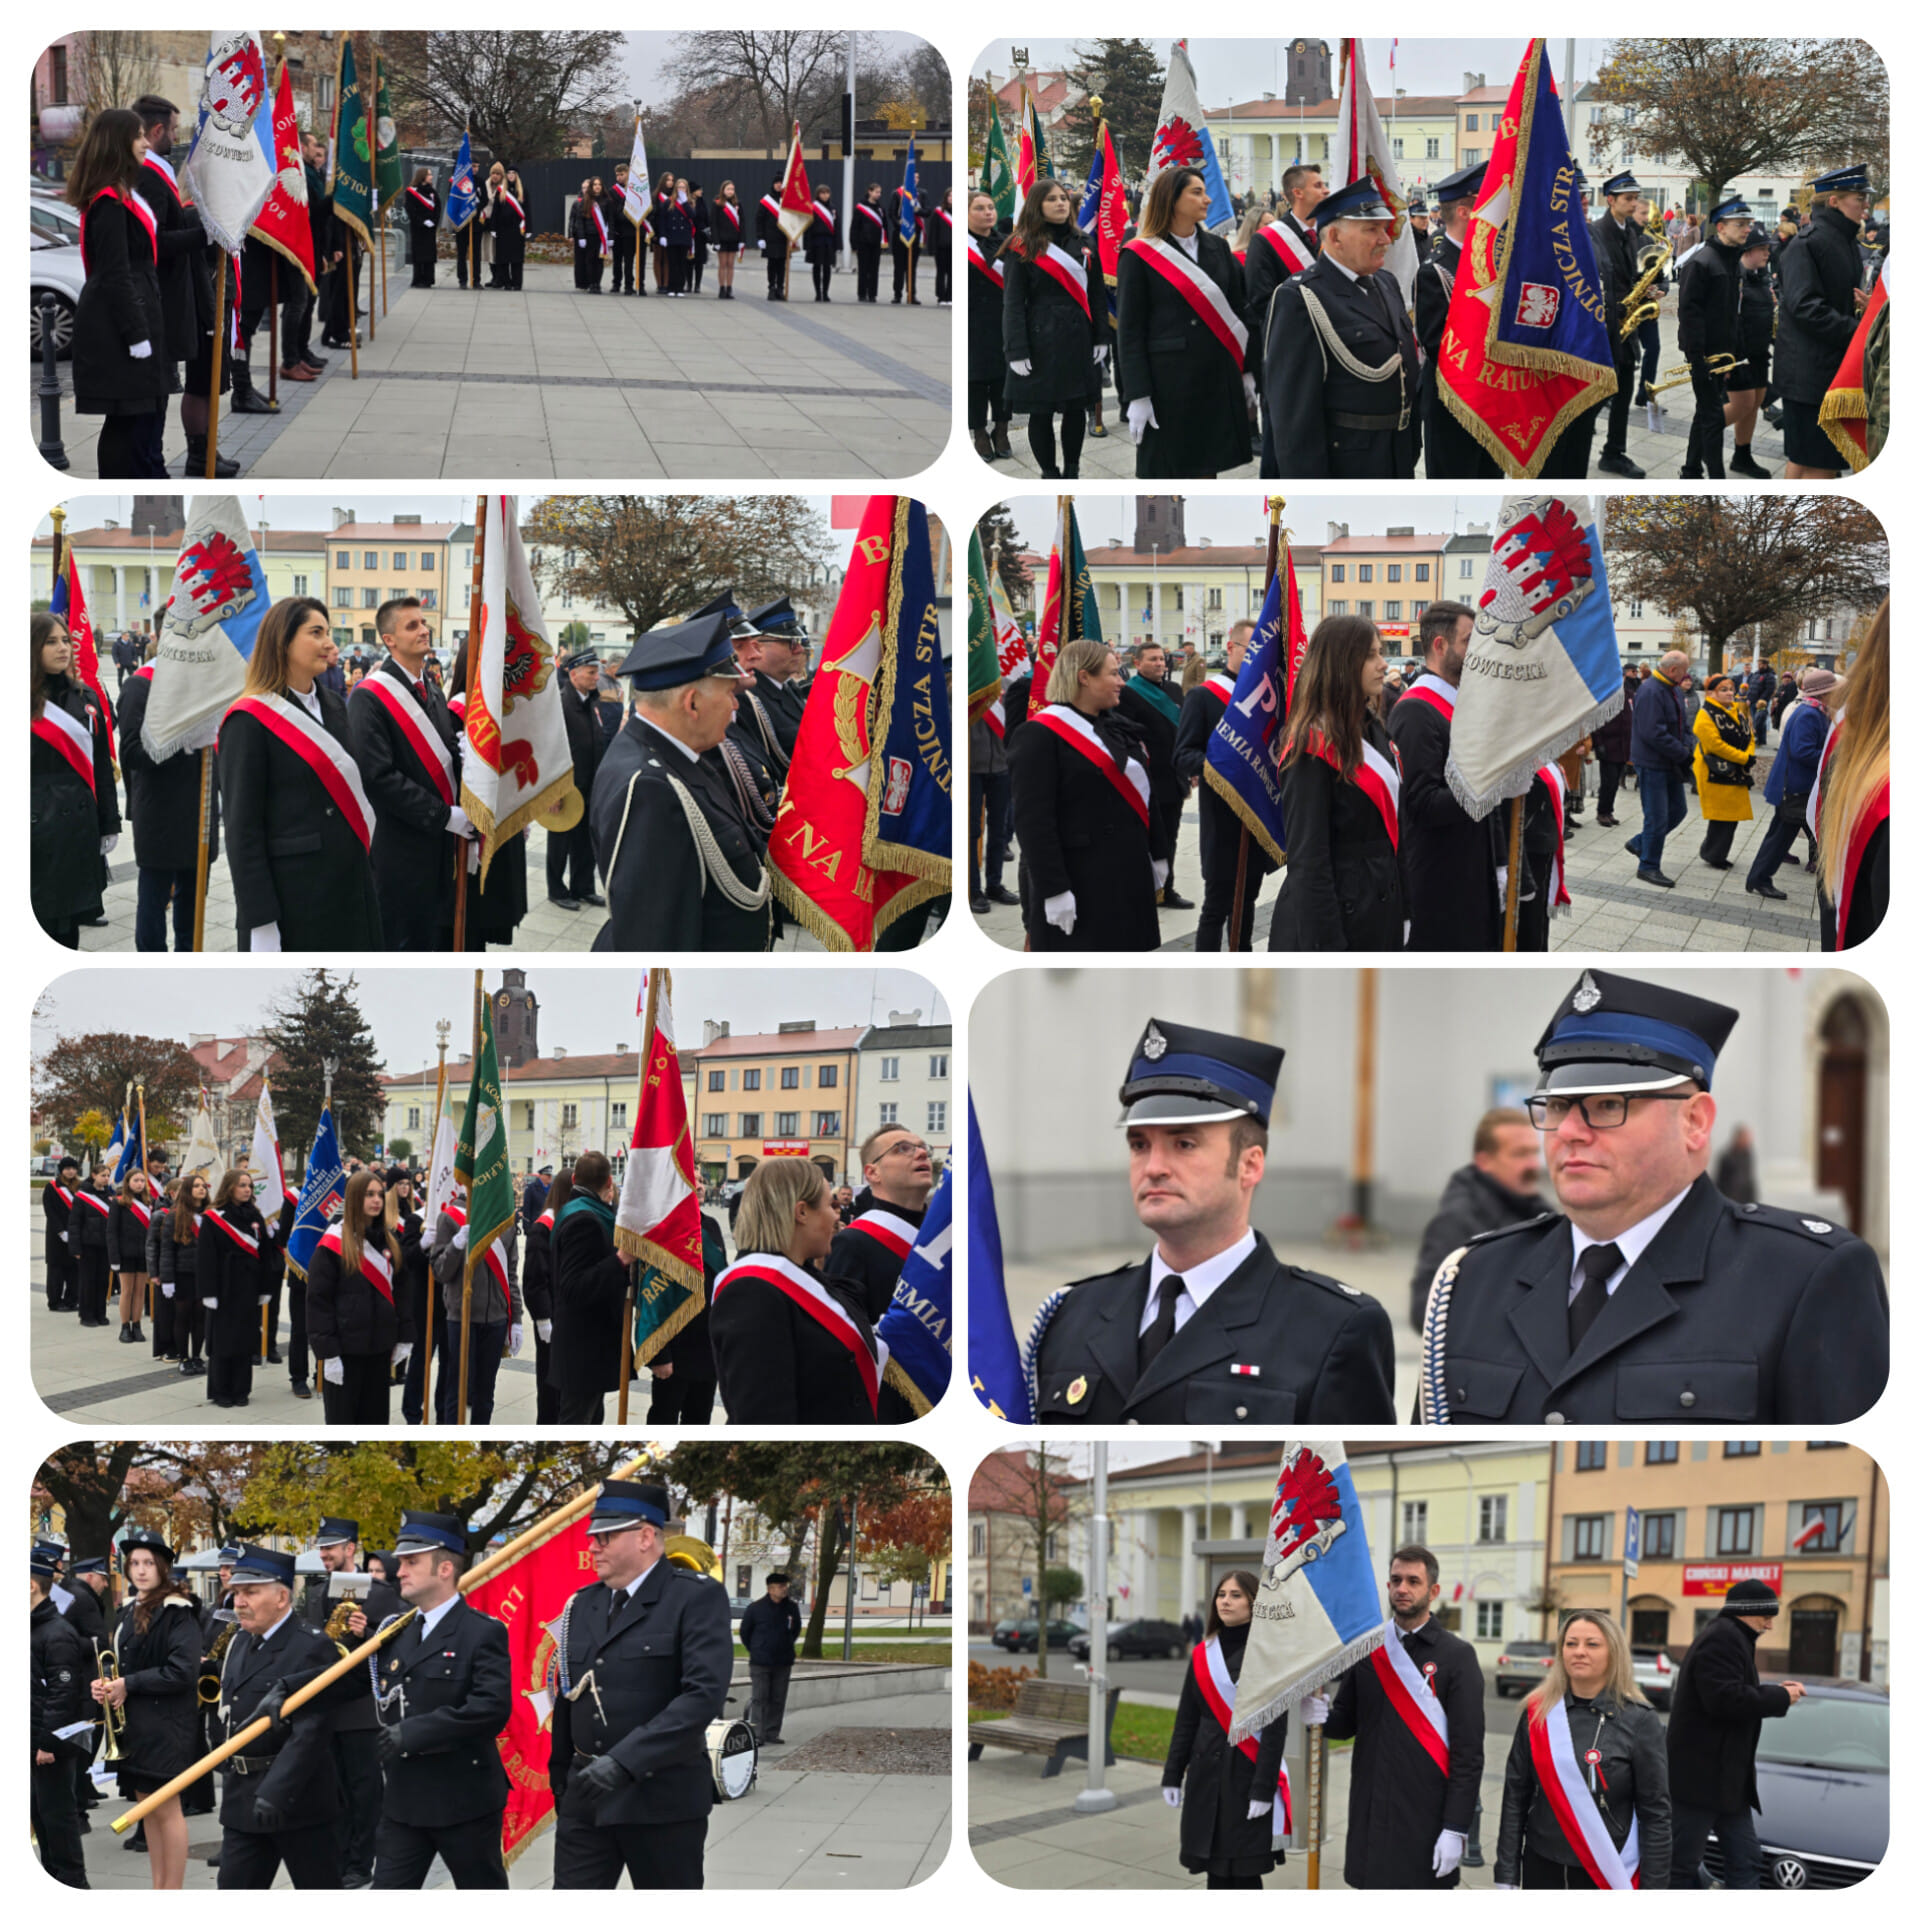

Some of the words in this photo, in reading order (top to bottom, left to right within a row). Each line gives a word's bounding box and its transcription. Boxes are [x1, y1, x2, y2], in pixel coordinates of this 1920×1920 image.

[1551, 152, 1575, 213] STR
[1440, 328, 1469, 372] NA
[856, 535, 892, 567] B
[915, 603, 938, 663] STR
[785, 820, 842, 882] NA
[727, 1734, 748, 1752] OSP
